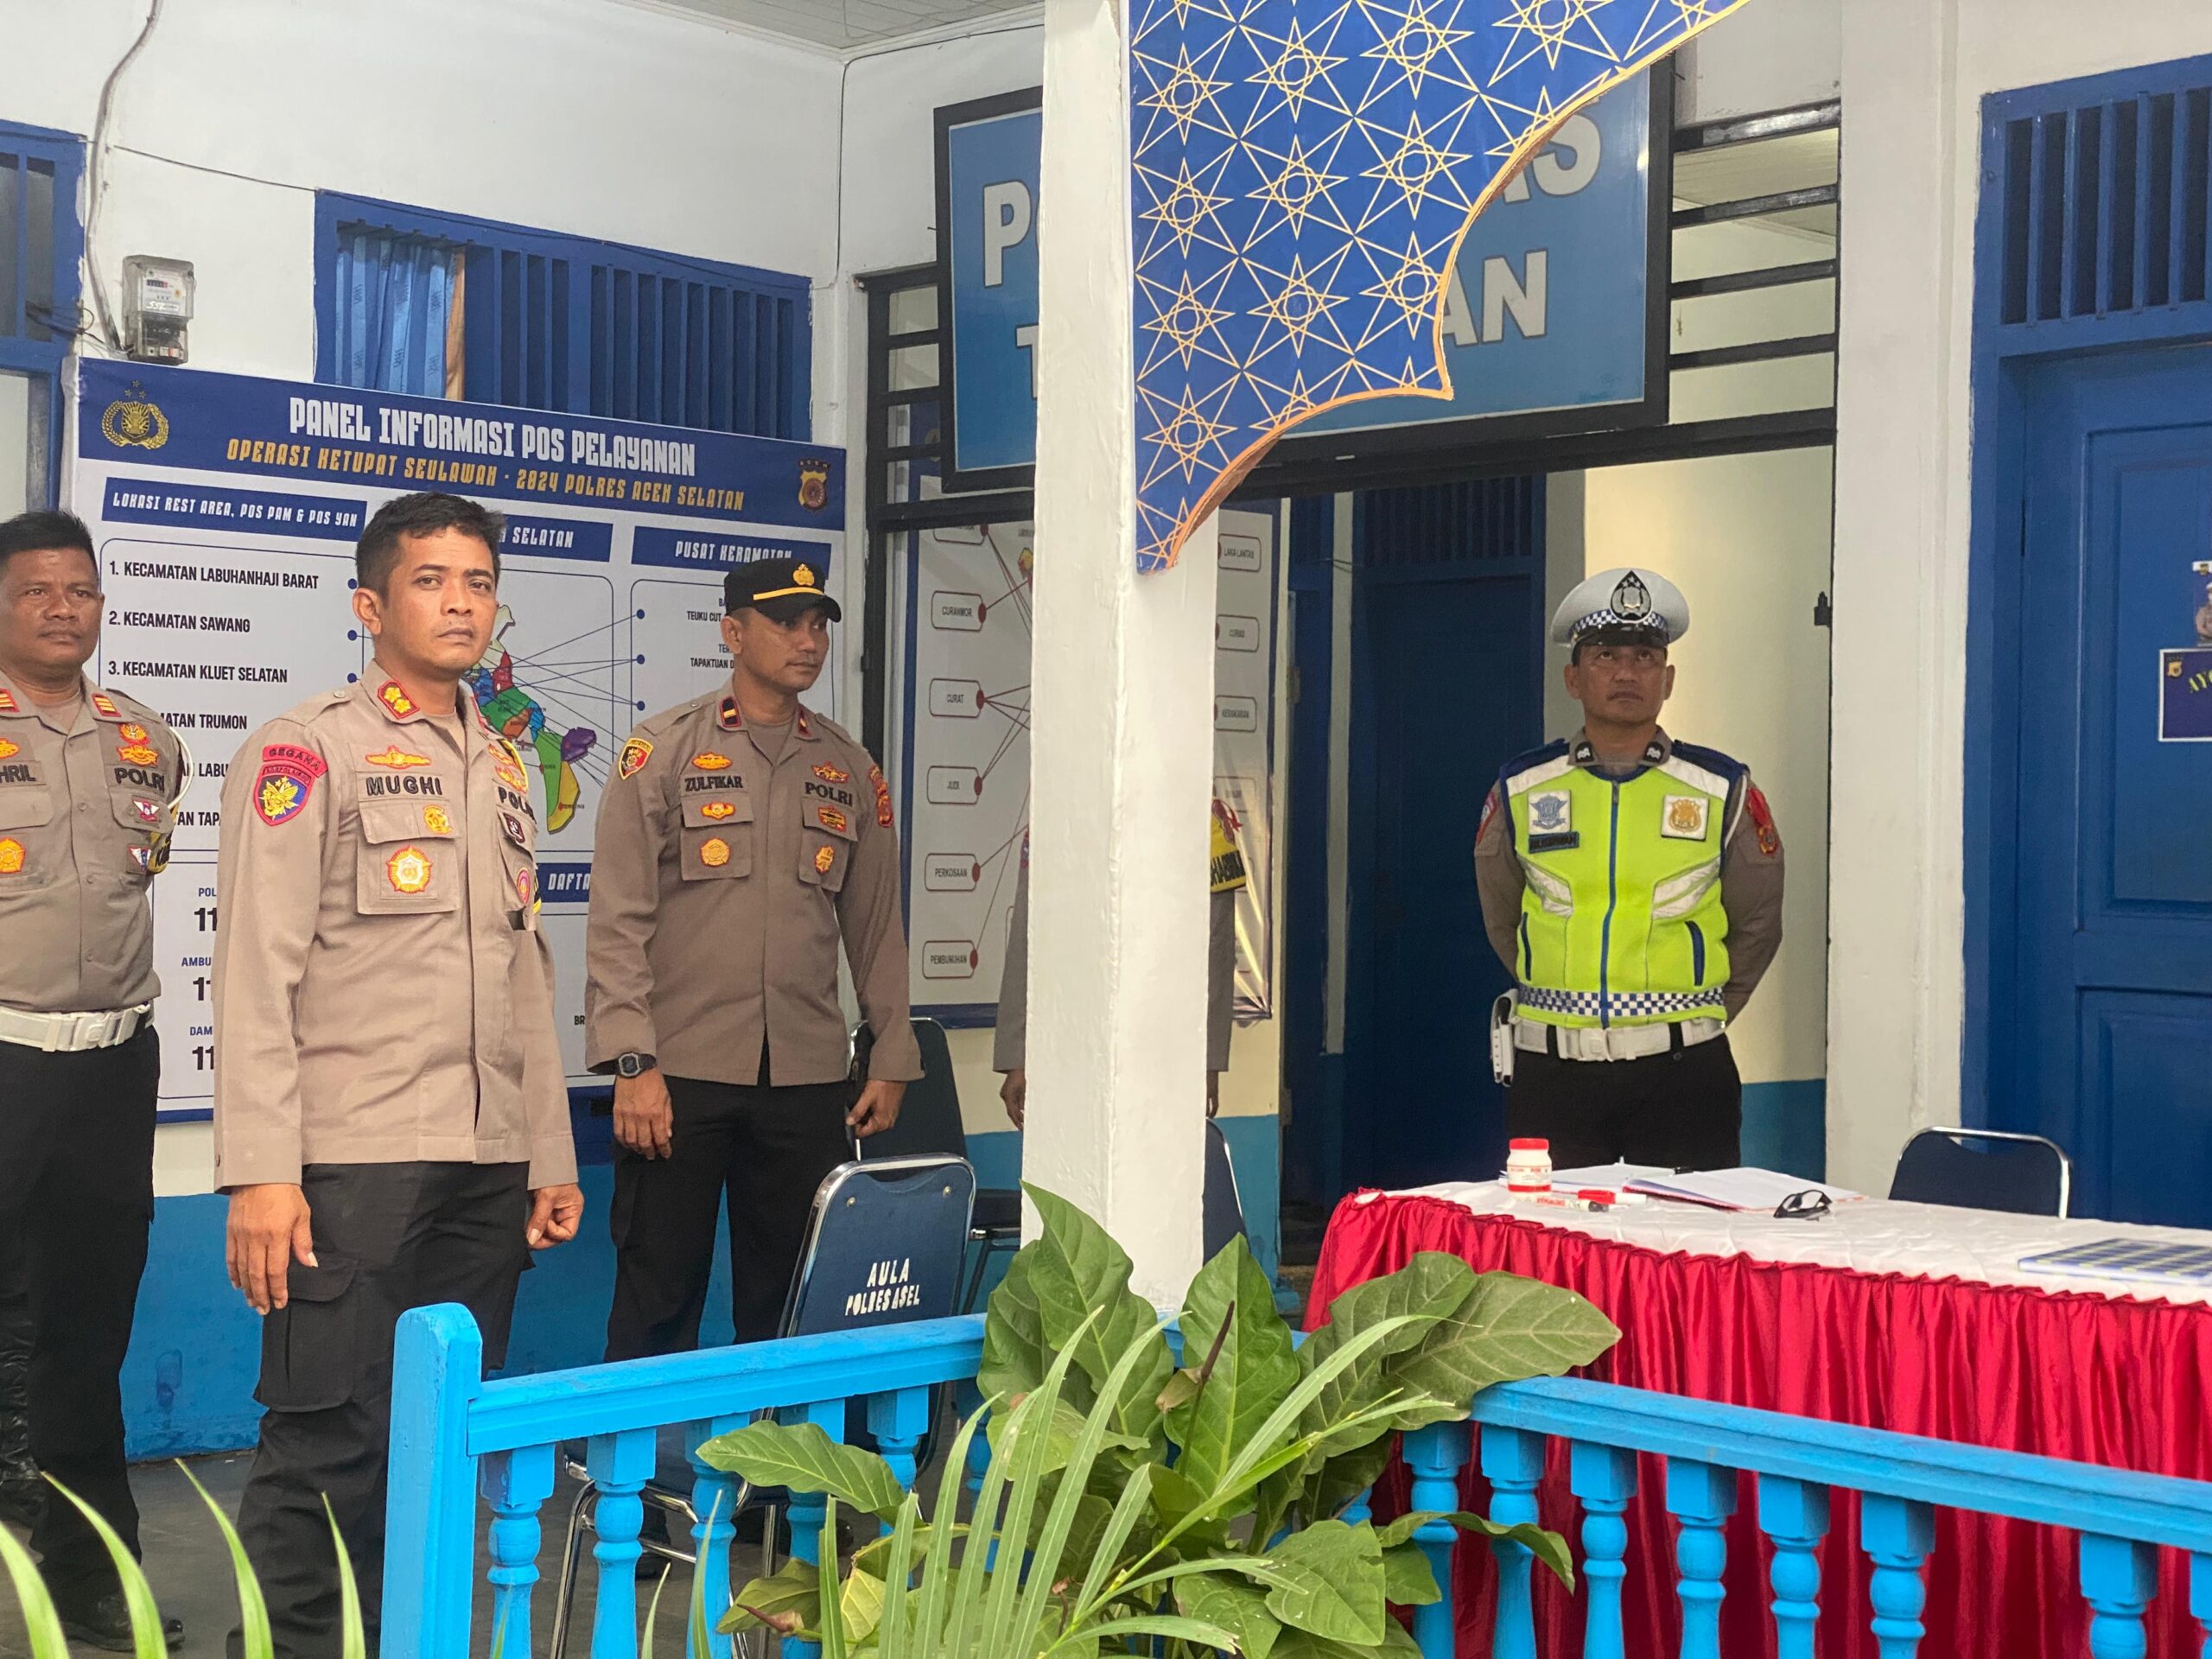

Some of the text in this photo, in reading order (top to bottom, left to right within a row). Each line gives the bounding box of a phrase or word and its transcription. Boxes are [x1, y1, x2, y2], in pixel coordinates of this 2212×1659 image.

[289, 397, 696, 477] PANEL INFORMASI POS PELAYANAN
[226, 438, 311, 467] OPERASI
[317, 448, 397, 477] KETUPAT
[404, 456, 497, 487] SEULAWAH
[516, 468, 559, 493] 2024
[564, 473, 626, 499] POLRES
[632, 481, 672, 505] ACEH
[677, 486, 745, 512] SELATAN
[112, 492, 358, 529] LOKASI REST AREA, POS PAM & POS YAN
[512, 526, 574, 549] SELATAN
[675, 540, 716, 560] PUSAT
[109, 561, 319, 590] 1. KECAMATAN LABUHANHAJI BARAT
[108, 610, 251, 633] 2. KECAMATAN SAWANG
[687, 610, 709, 621] TEUKU
[107, 660, 288, 683] 3. KECAMATAN KLUET SELATAN
[690, 658, 728, 670] TAPAKTUAN
[160, 713, 248, 730] ATAN TRUMON
[269, 747, 321, 771] GEGANA
[365, 775, 443, 797] MUGHI
[684, 775, 744, 792] ZULFIKAR
[804, 781, 854, 807] POLRI
[198, 811, 222, 827] TAP
[866, 1257, 910, 1287] AULA
[844, 1287, 892, 1316] POLRES
